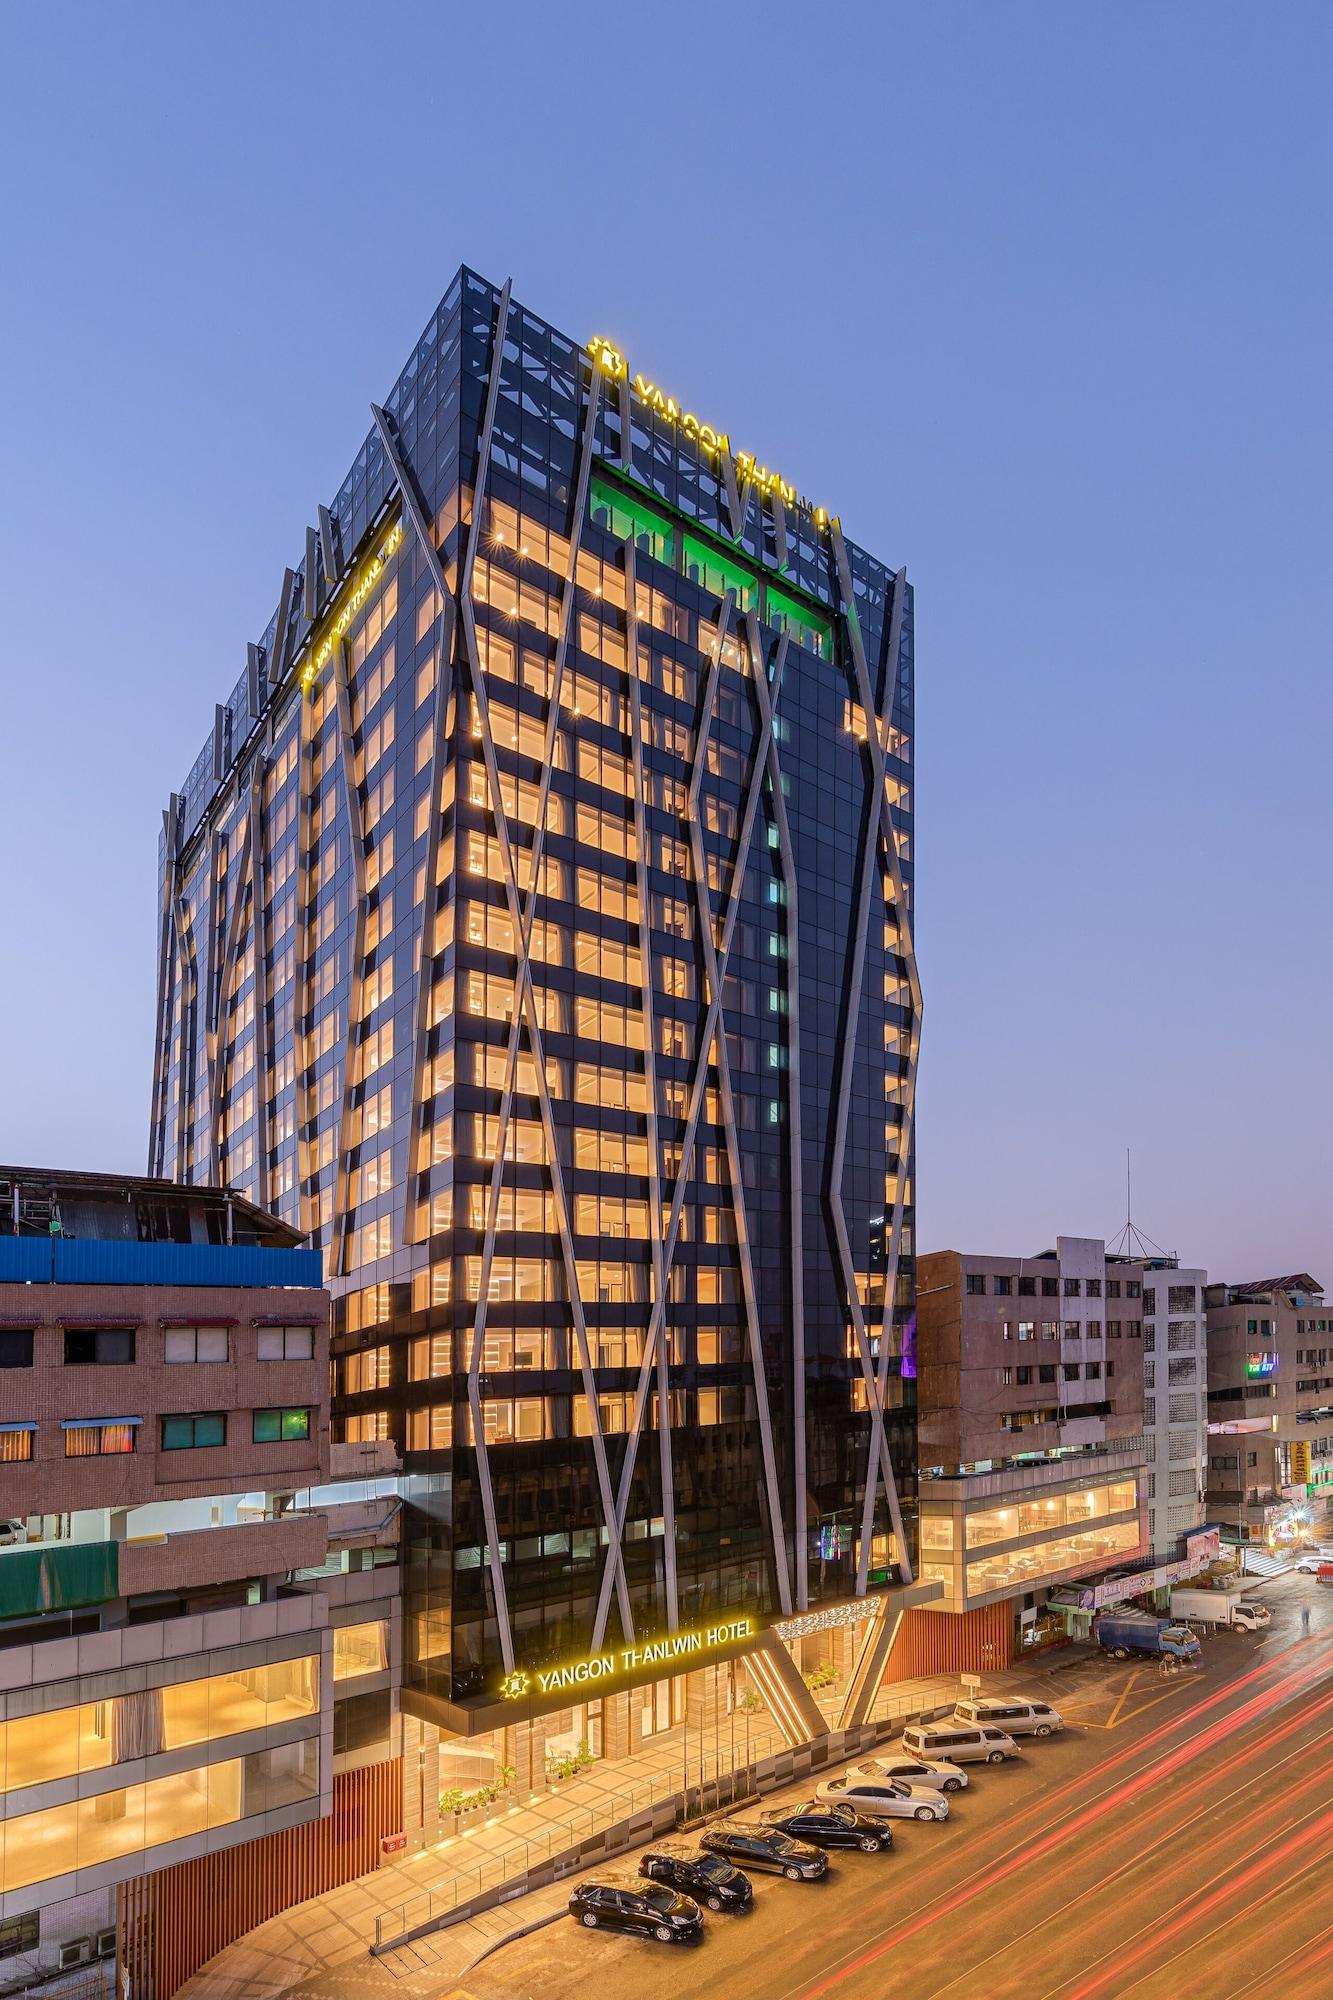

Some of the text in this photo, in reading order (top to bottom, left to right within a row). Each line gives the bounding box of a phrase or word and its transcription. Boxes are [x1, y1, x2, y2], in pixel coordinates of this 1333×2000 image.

[538, 1619, 754, 1693] YANGON THANLWIN HOTEL
